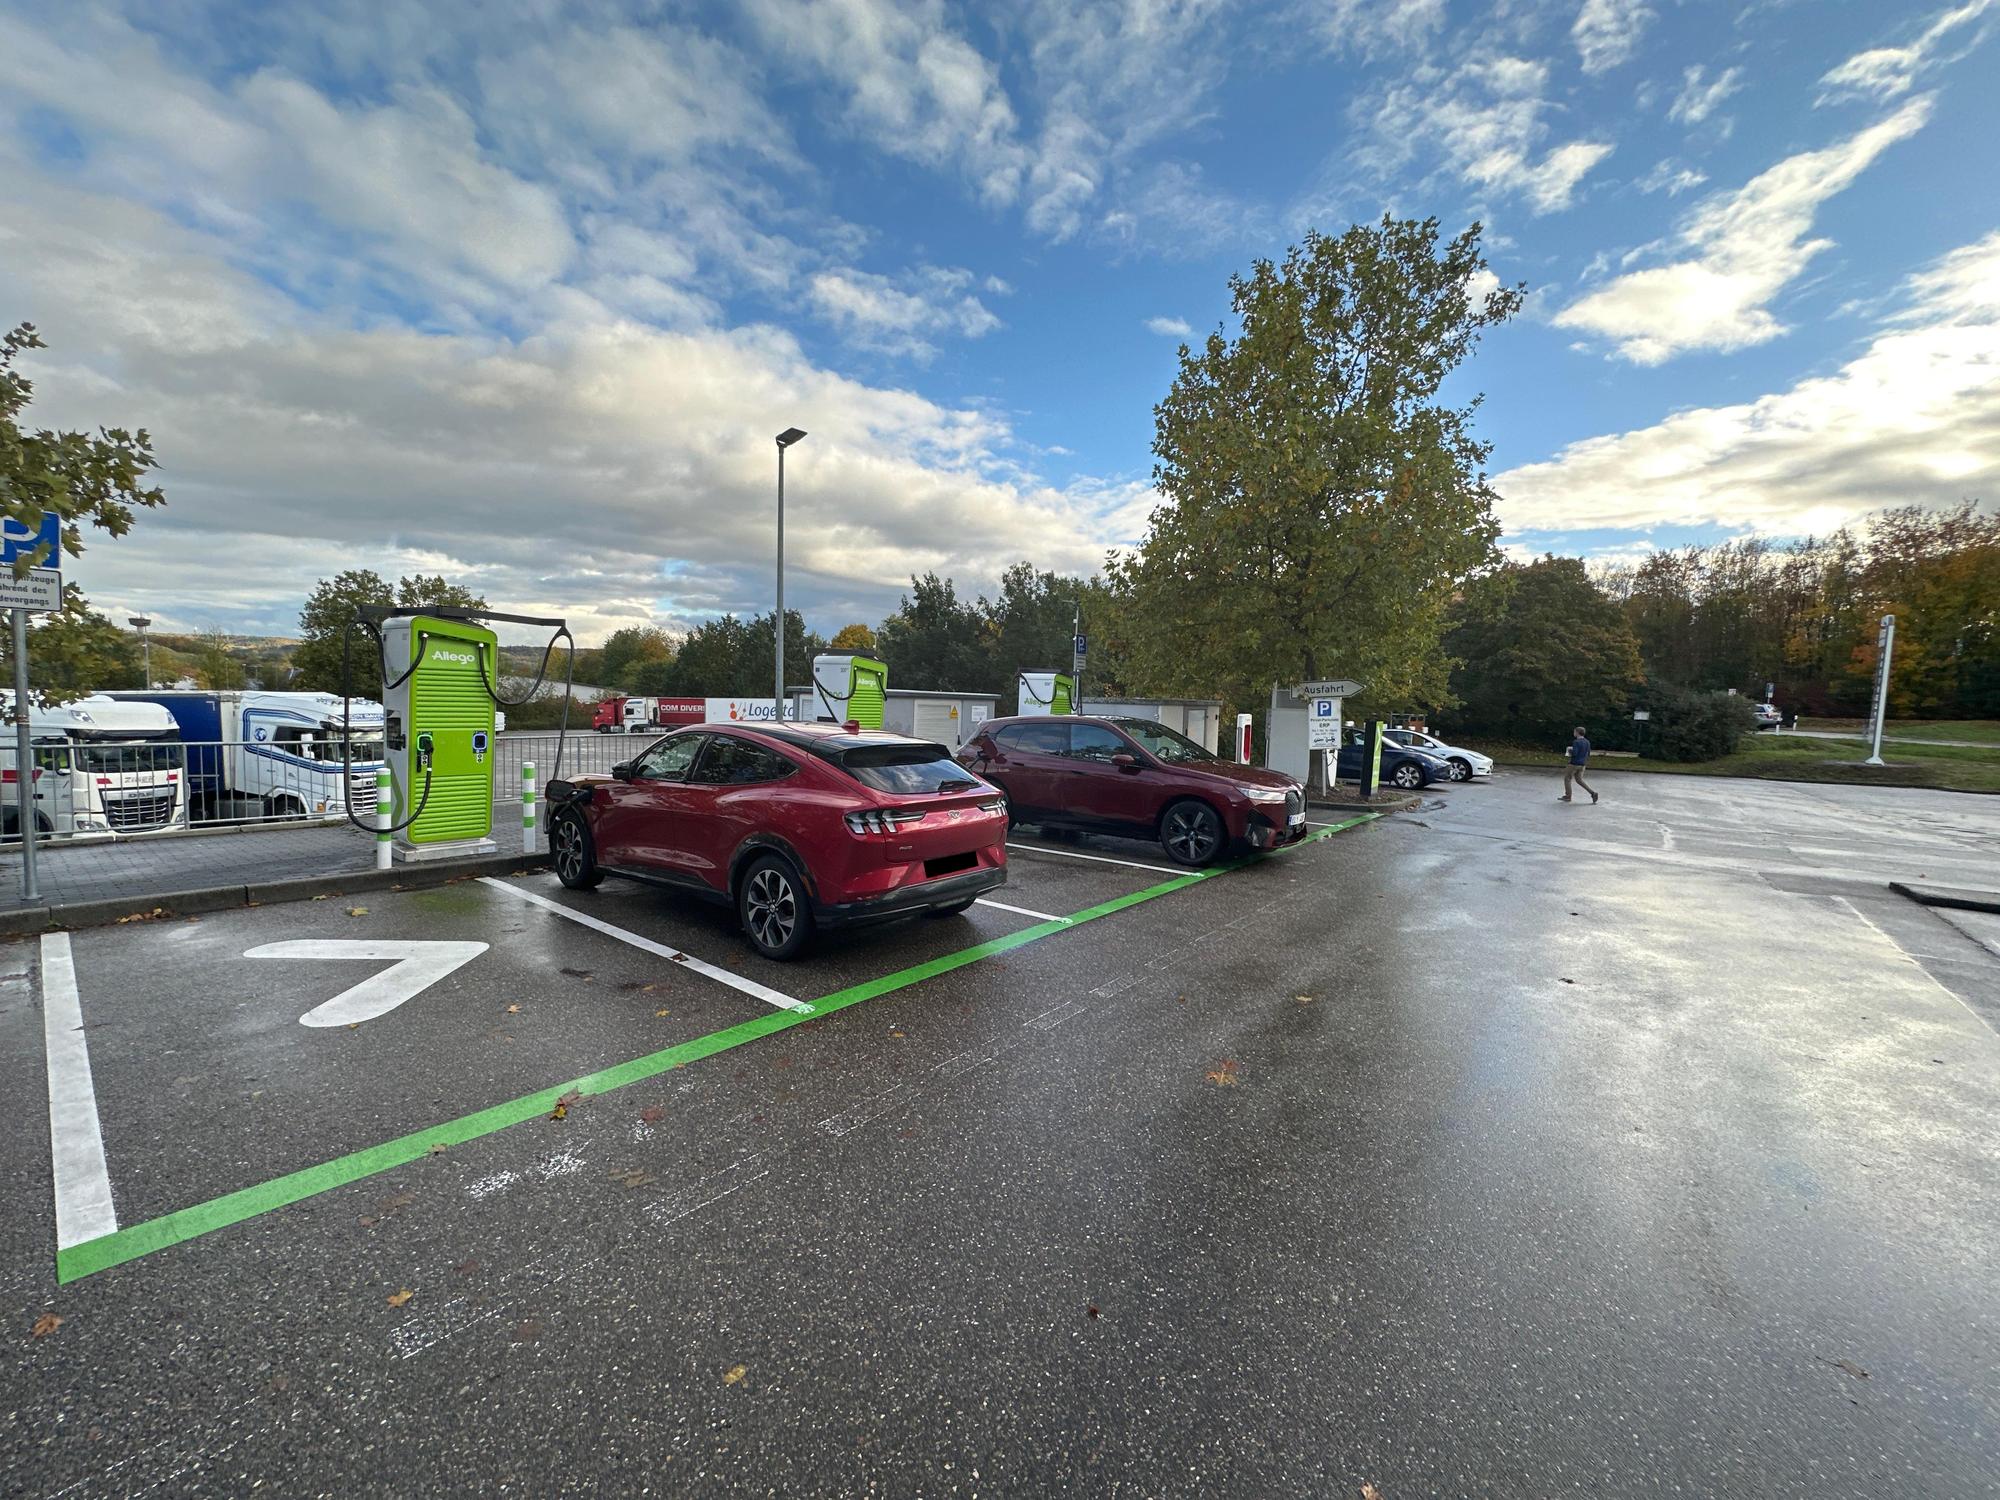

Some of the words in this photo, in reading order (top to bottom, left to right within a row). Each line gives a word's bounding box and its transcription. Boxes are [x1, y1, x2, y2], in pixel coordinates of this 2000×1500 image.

[32, 586, 48, 594] des
[432, 651, 475, 664] Allego
[1304, 685, 1344, 694] Ausfahrt
[680, 704, 705, 712] DIVER
[1320, 702, 1330, 715] P
